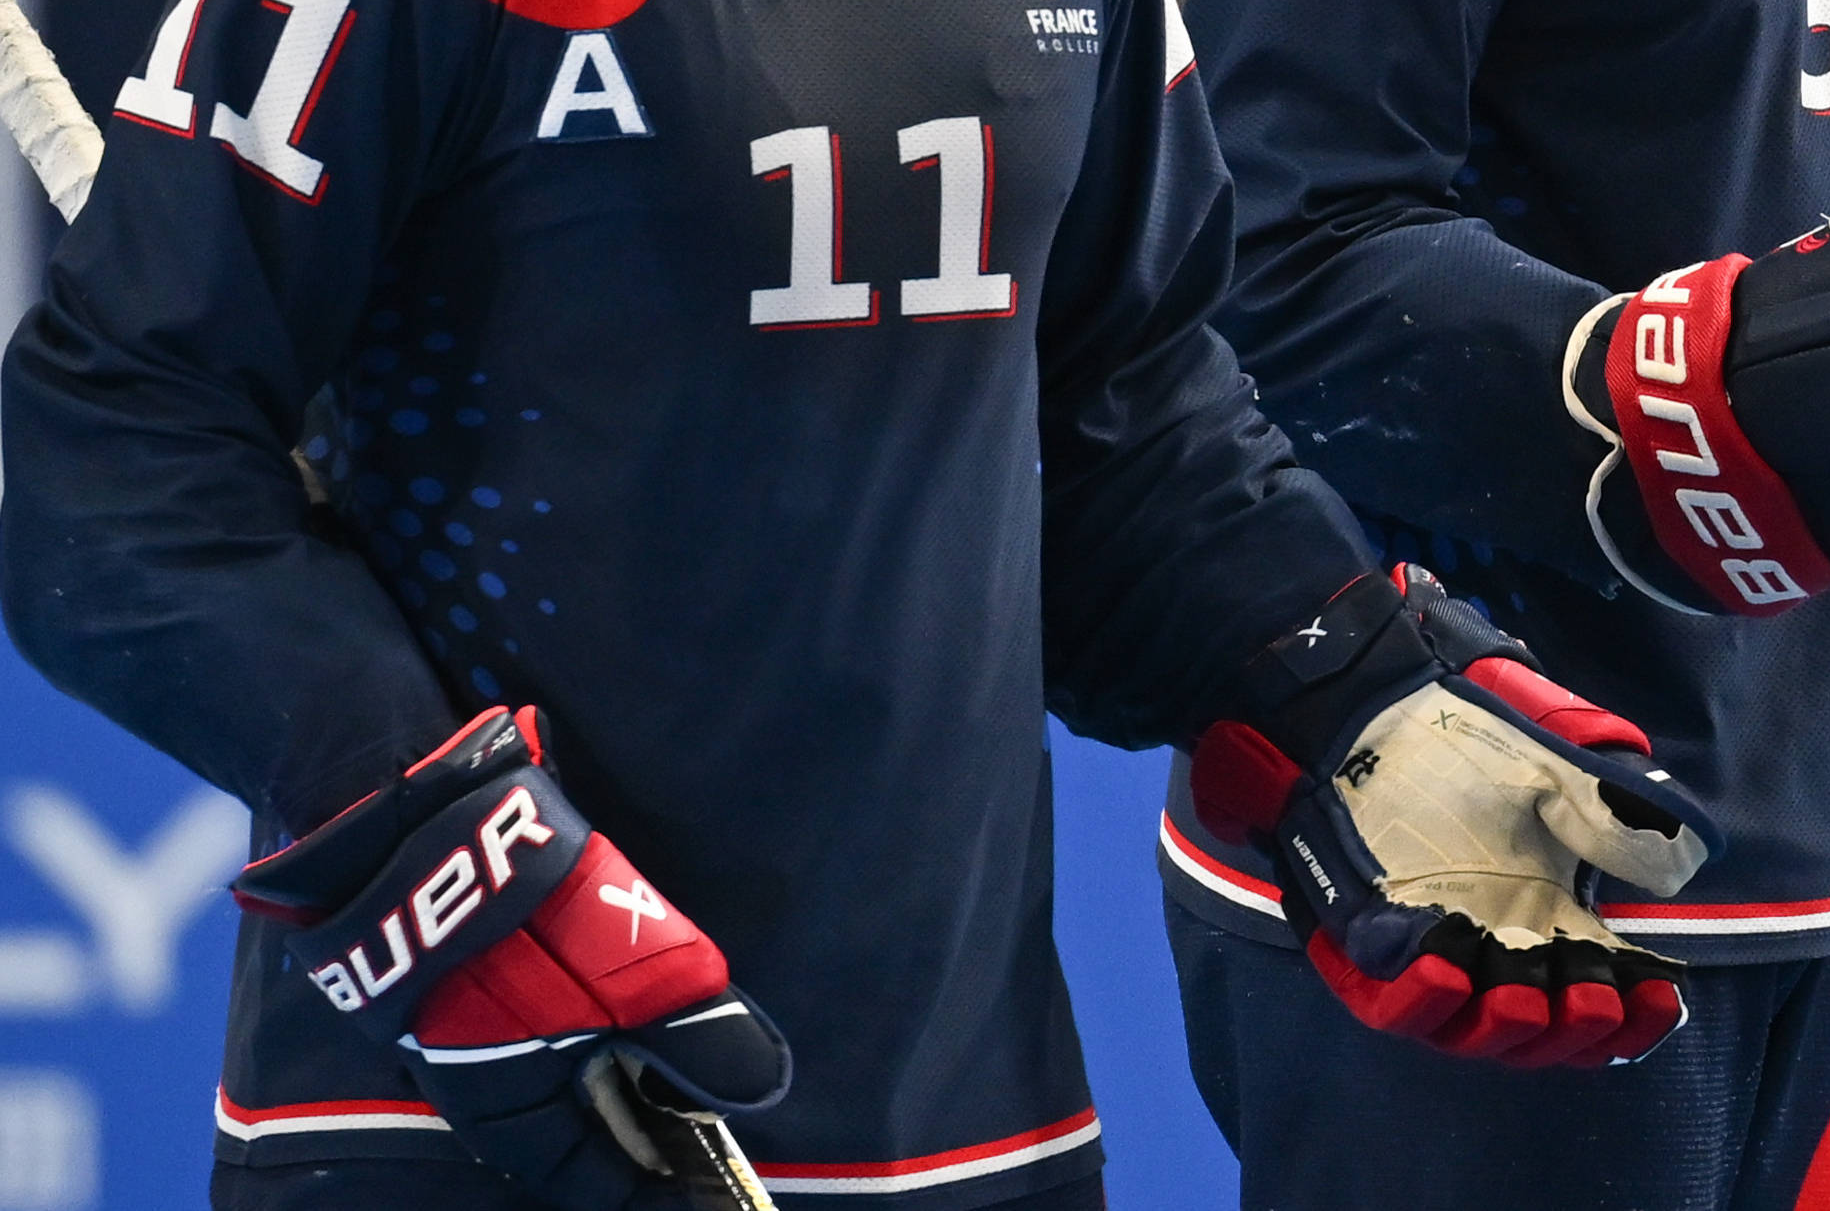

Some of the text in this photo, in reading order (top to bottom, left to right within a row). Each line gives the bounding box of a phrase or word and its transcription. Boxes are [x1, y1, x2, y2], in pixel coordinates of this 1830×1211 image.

[1026, 8, 1099, 36] FRANCE
[537, 33, 649, 139] A
[749, 116, 1018, 330] 11
